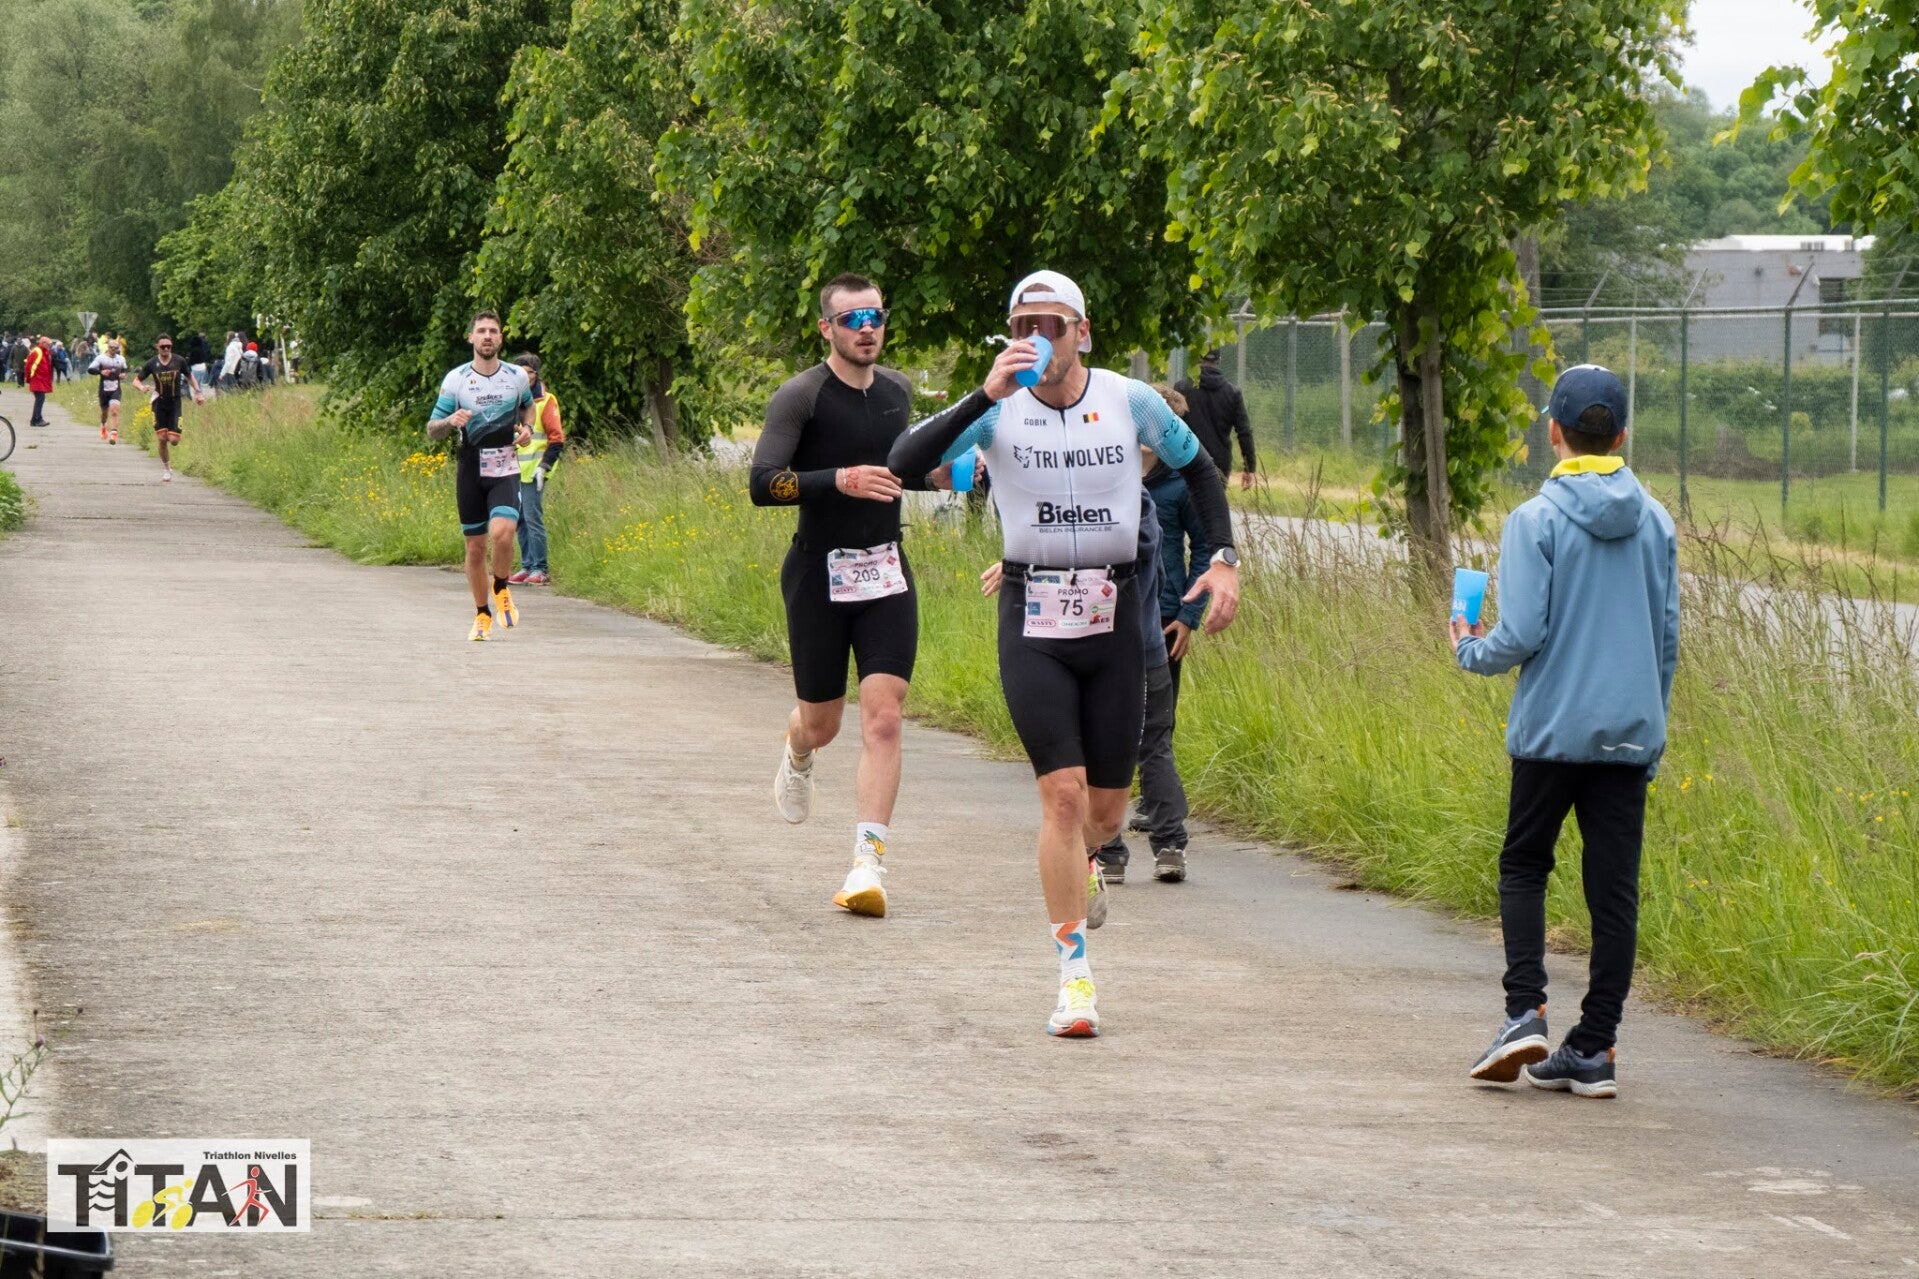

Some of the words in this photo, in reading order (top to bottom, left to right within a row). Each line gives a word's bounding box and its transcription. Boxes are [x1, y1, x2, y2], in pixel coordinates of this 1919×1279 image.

[1024, 418, 1048, 426] GOBIK
[1033, 450, 1058, 469] TRI
[1062, 445, 1125, 469] WOLVES
[1038, 501, 1112, 524] Bielen
[854, 560, 878, 568] PROMO
[853, 568, 880, 583] 209
[1057, 588, 1089, 596] PROMO
[1060, 600, 1083, 616] 75
